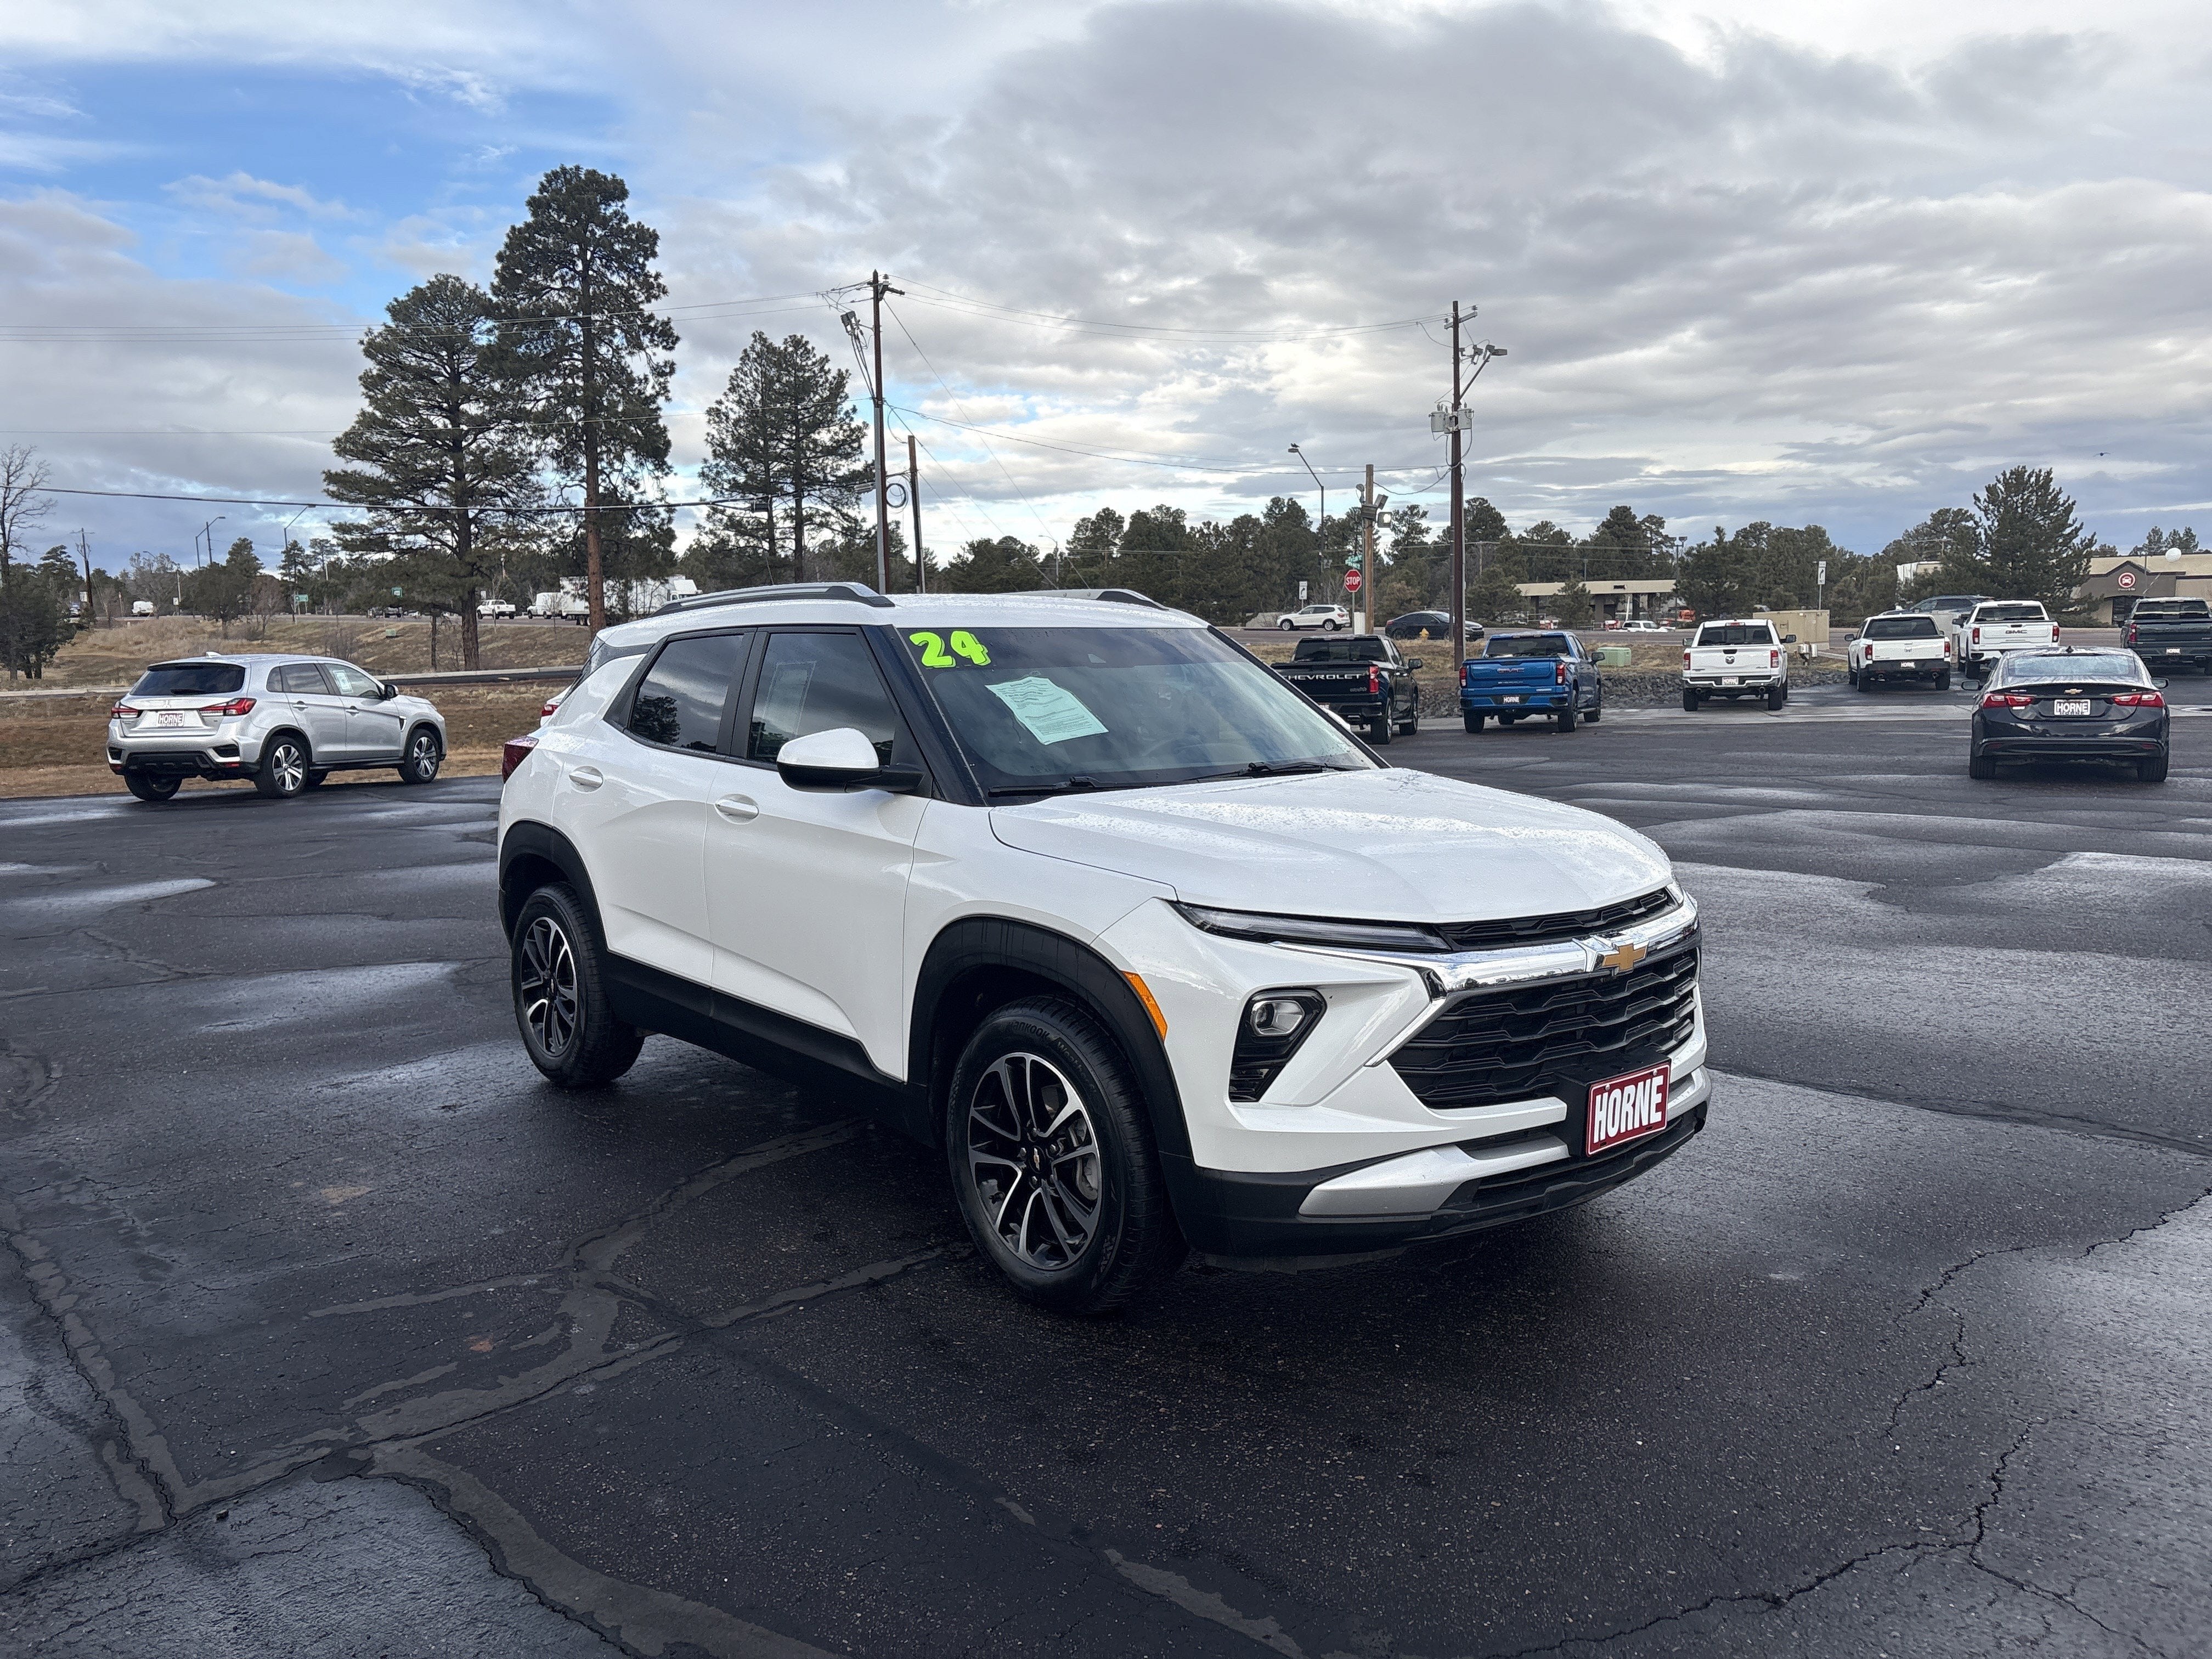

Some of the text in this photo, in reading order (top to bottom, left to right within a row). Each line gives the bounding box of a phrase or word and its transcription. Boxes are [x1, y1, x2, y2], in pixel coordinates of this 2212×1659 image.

[1346, 576, 1361, 585] STOP
[909, 630, 991, 668] 24
[2057, 702, 2088, 713] HORNE
[159, 714, 183, 723] HORNE
[1593, 1075, 1664, 1144] HORNE
